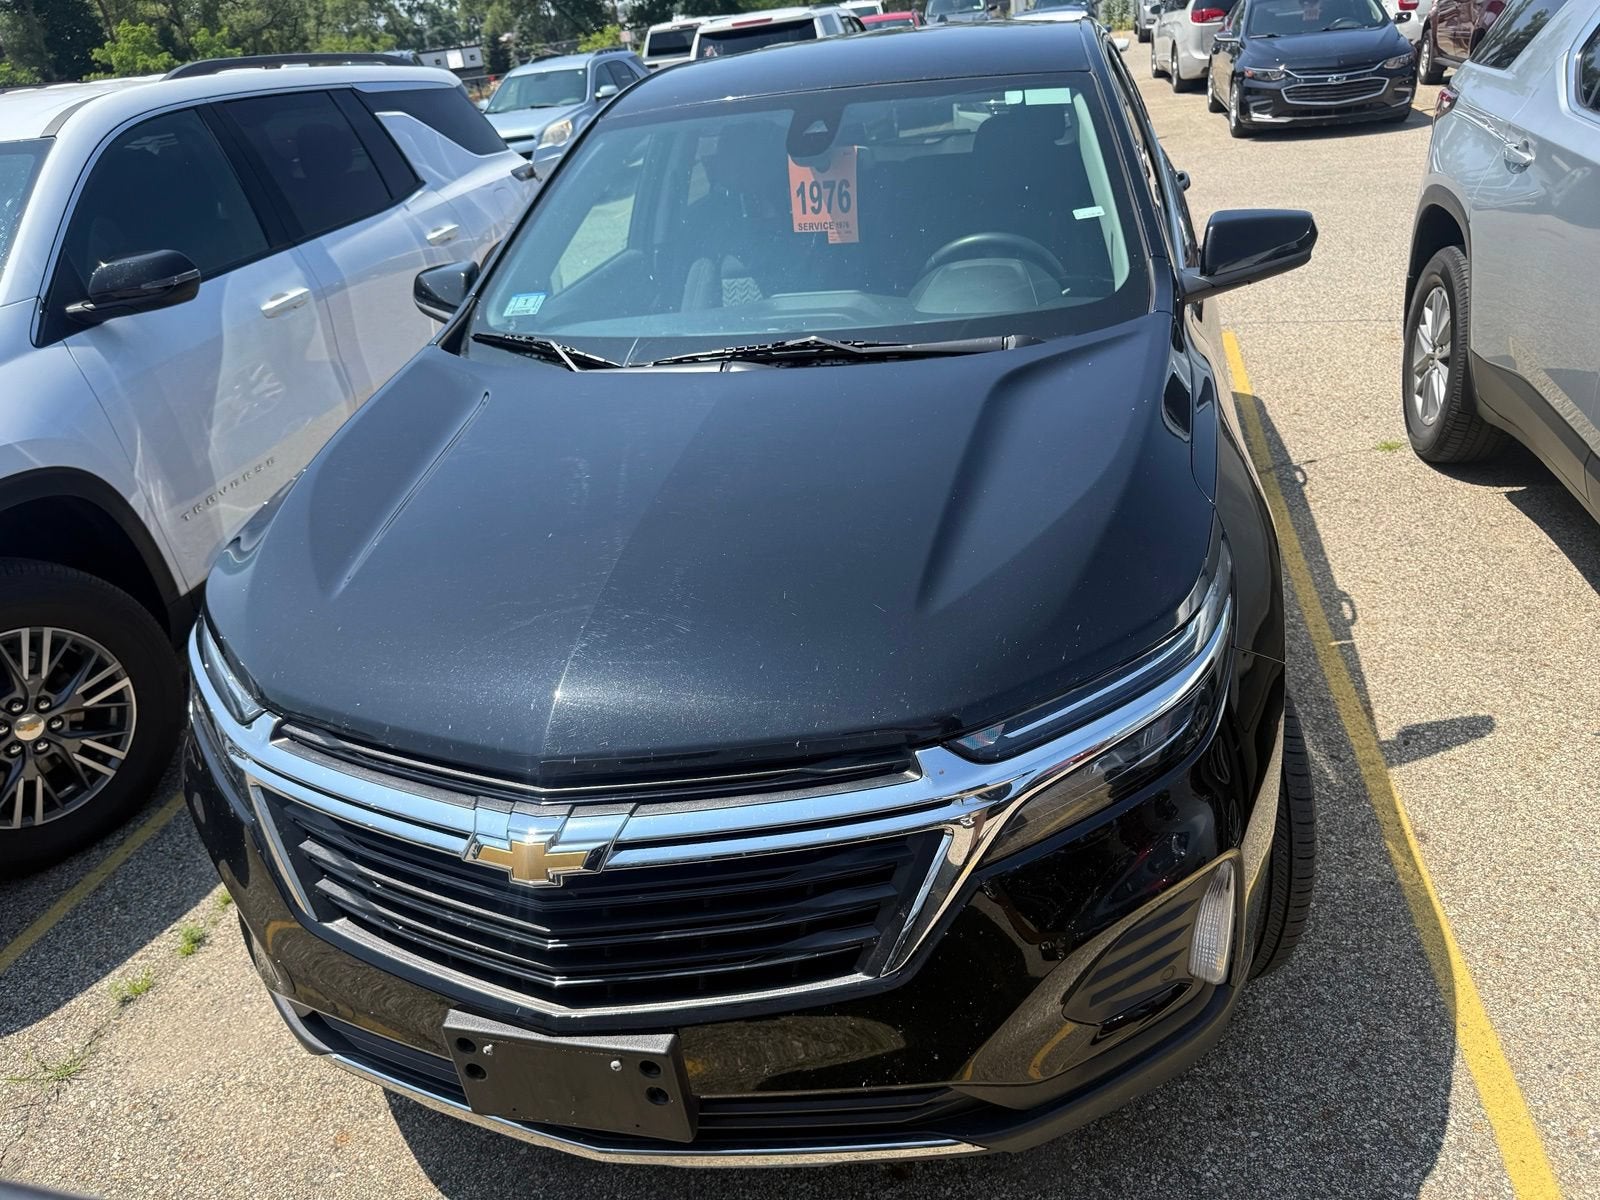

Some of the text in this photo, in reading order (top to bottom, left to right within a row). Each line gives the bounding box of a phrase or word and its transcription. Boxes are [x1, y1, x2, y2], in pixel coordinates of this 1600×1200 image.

[796, 178, 851, 215] 1976
[798, 221, 834, 231] SERVICE
[181, 457, 275, 521] TRAVERSE
